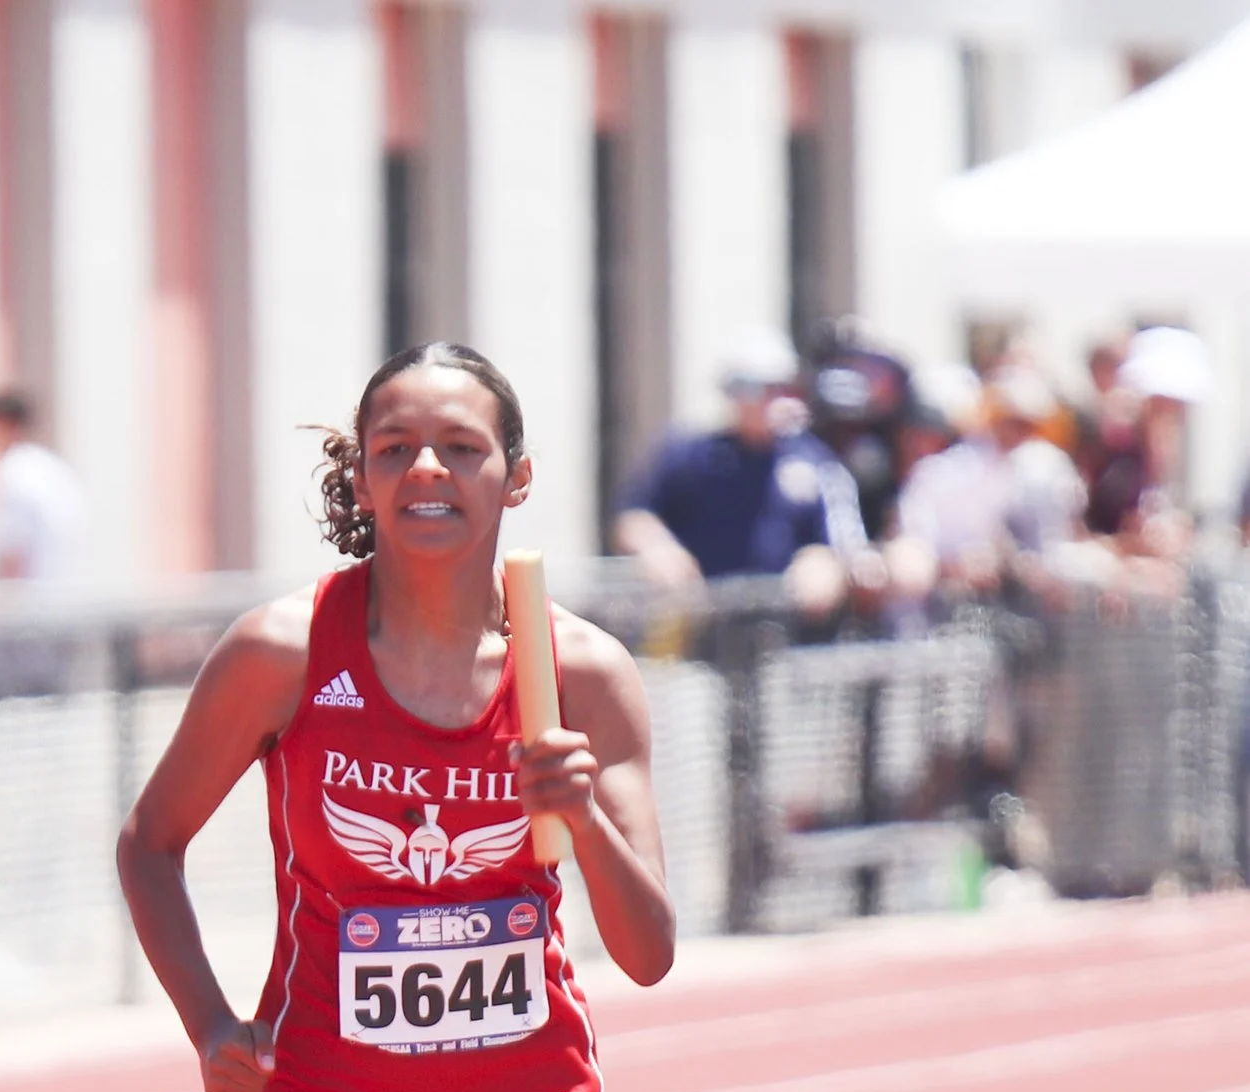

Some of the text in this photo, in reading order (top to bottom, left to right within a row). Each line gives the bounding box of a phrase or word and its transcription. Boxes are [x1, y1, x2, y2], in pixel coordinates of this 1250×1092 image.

[314, 692, 365, 709] adidas
[321, 749, 519, 801] PARK HIL
[397, 912, 492, 944] ZERO
[354, 952, 533, 1029] 5644
